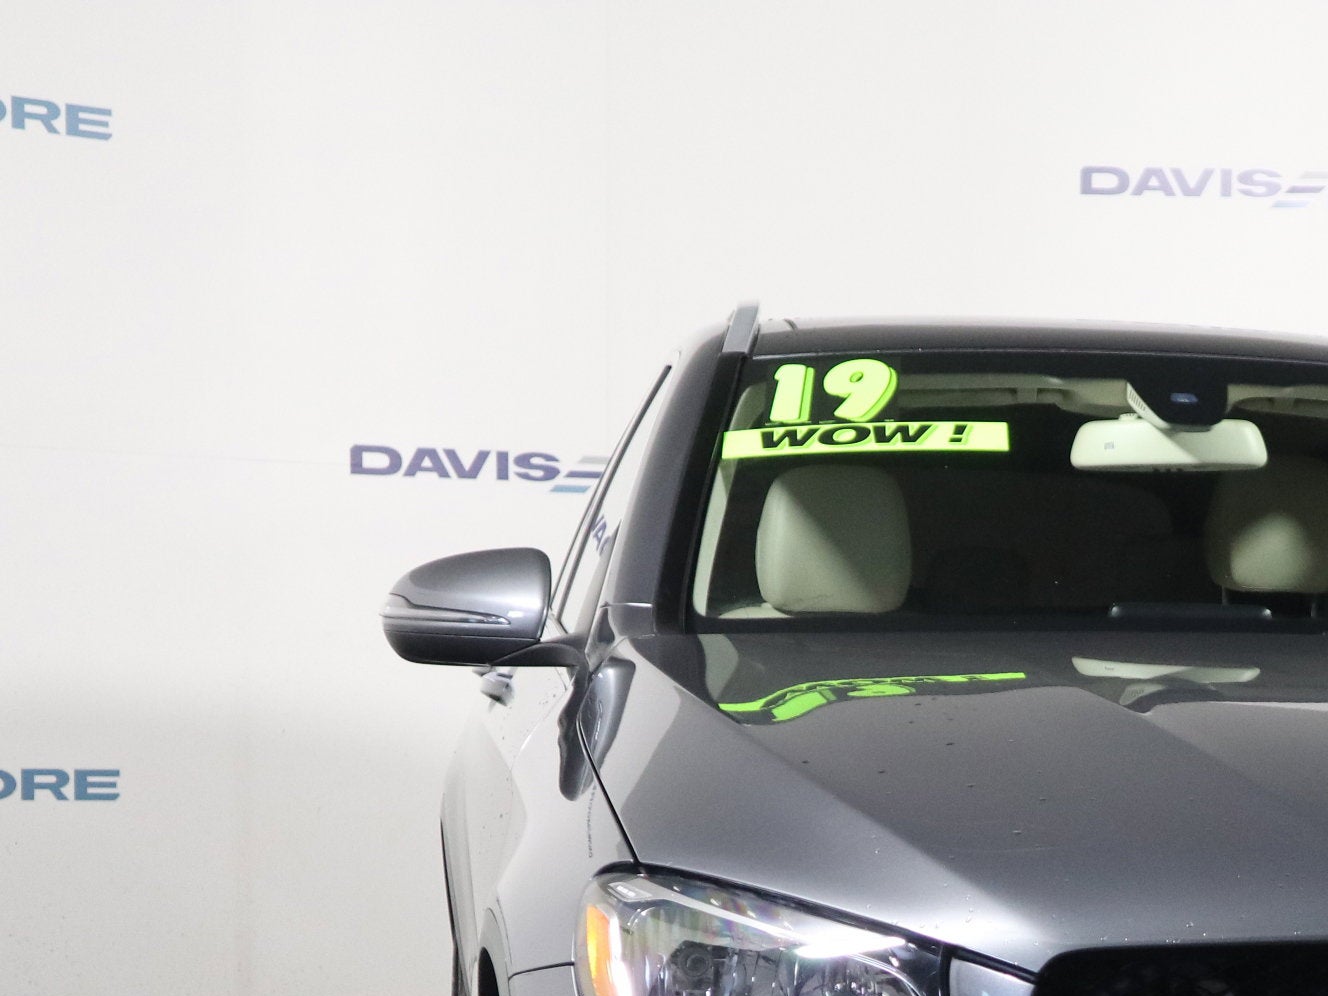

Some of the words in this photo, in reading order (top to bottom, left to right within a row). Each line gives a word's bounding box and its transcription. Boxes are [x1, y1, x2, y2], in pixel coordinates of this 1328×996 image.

[0, 95, 113, 141] RE
[1079, 165, 1282, 198] DAVIS
[769, 357, 898, 423] 19
[349, 443, 562, 482] DAVIS
